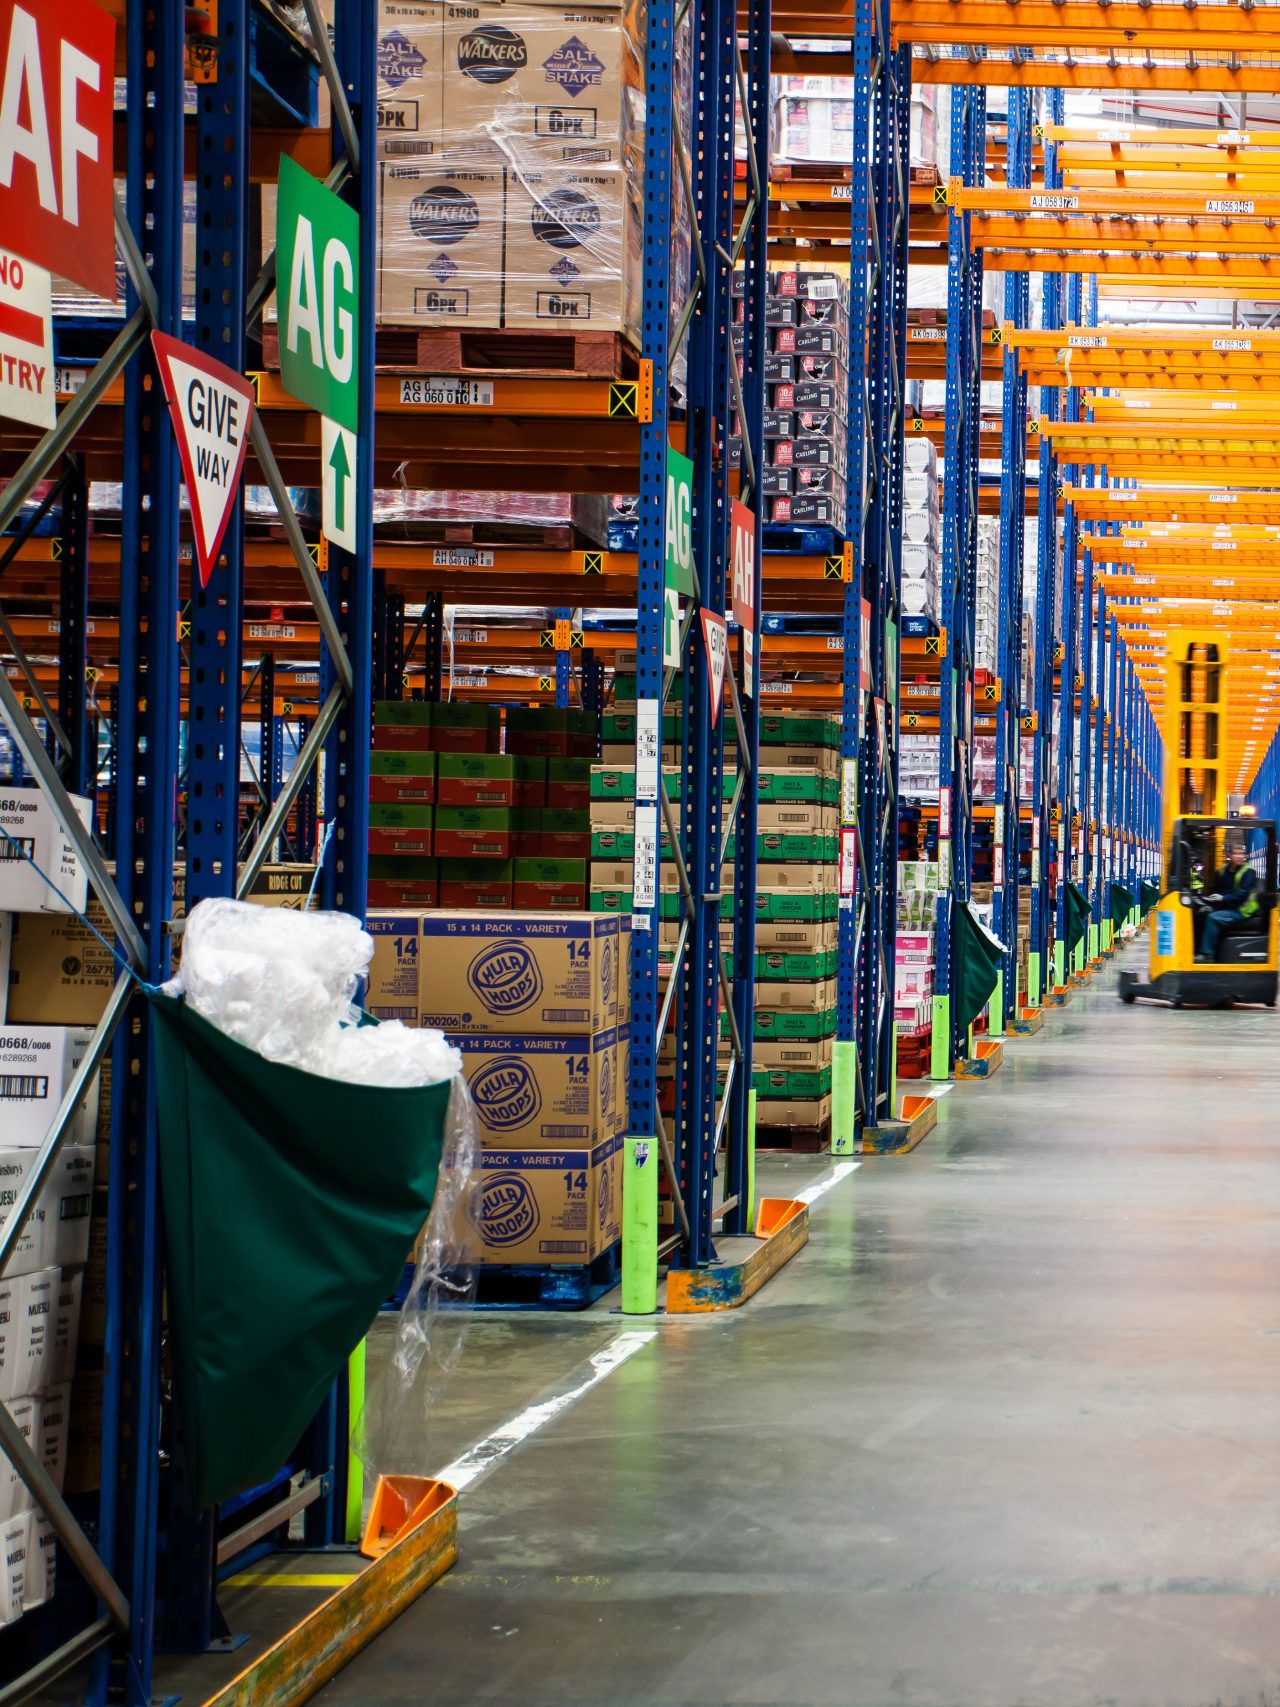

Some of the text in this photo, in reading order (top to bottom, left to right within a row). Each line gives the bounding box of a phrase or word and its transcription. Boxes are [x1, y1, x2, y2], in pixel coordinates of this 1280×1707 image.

[458, 39, 527, 60] WALKERS
[552, 49, 596, 62] SALT
[377, 64, 424, 78] HAKE
[545, 70, 602, 85] SHAKE
[0, 9, 100, 228] AF
[549, 110, 583, 133] 6PK
[1032, 196, 1043, 206] AJ
[1208, 201, 1219, 211] AJ
[0, 255, 23, 290] NO
[287, 214, 353, 384] AG
[427, 292, 457, 313] 6PK
[549, 295, 579, 316] 6PK
[798, 337, 819, 346] CARLING
[0, 354, 46, 395] TRY
[403, 381, 420, 391] AG
[403, 392, 420, 402] AG
[425, 393, 444, 403] 060
[796, 393, 818, 402] CARLING
[188, 378, 238, 447] GIVE
[796, 449, 817, 458] CARLING
[197, 445, 230, 488] WAY
[794, 505, 815, 514] CARLING
[666, 475, 690, 570] AG
[733, 525, 754, 608] AH
[269, 875, 302, 890] RIDGE CUT
[366, 922, 395, 931] RIETY
[447, 923, 457, 932] 15
[470, 924, 481, 933] 14
[485, 924, 513, 933] PACK
[526, 924, 569, 934] VARIETY
[394, 937, 418, 958] 14
[567, 939, 591, 960] 14
[397, 958, 417, 966] PACK
[482, 954, 522, 983] HULA
[570, 960, 589, 968] PACK
[489, 973, 534, 1004] HOOPS
[423, 1016, 459, 1028] 700206
[469, 1040, 479, 1049] 14
[484, 1040, 512, 1049] PACK
[524, 1041, 567, 1050] VARIETY
[566, 1056, 590, 1076] 14
[481, 1071, 520, 1099] HULA
[486, 1091, 531, 1120] HOOPS
[481, 1156, 565, 1165] PACK VARIETY
[564, 1171, 588, 1192] 14
[567, 1192, 586, 1200] PACK
[484, 1206, 529, 1236] HOOPS
[28, 1302, 50, 1317] MUESLI
